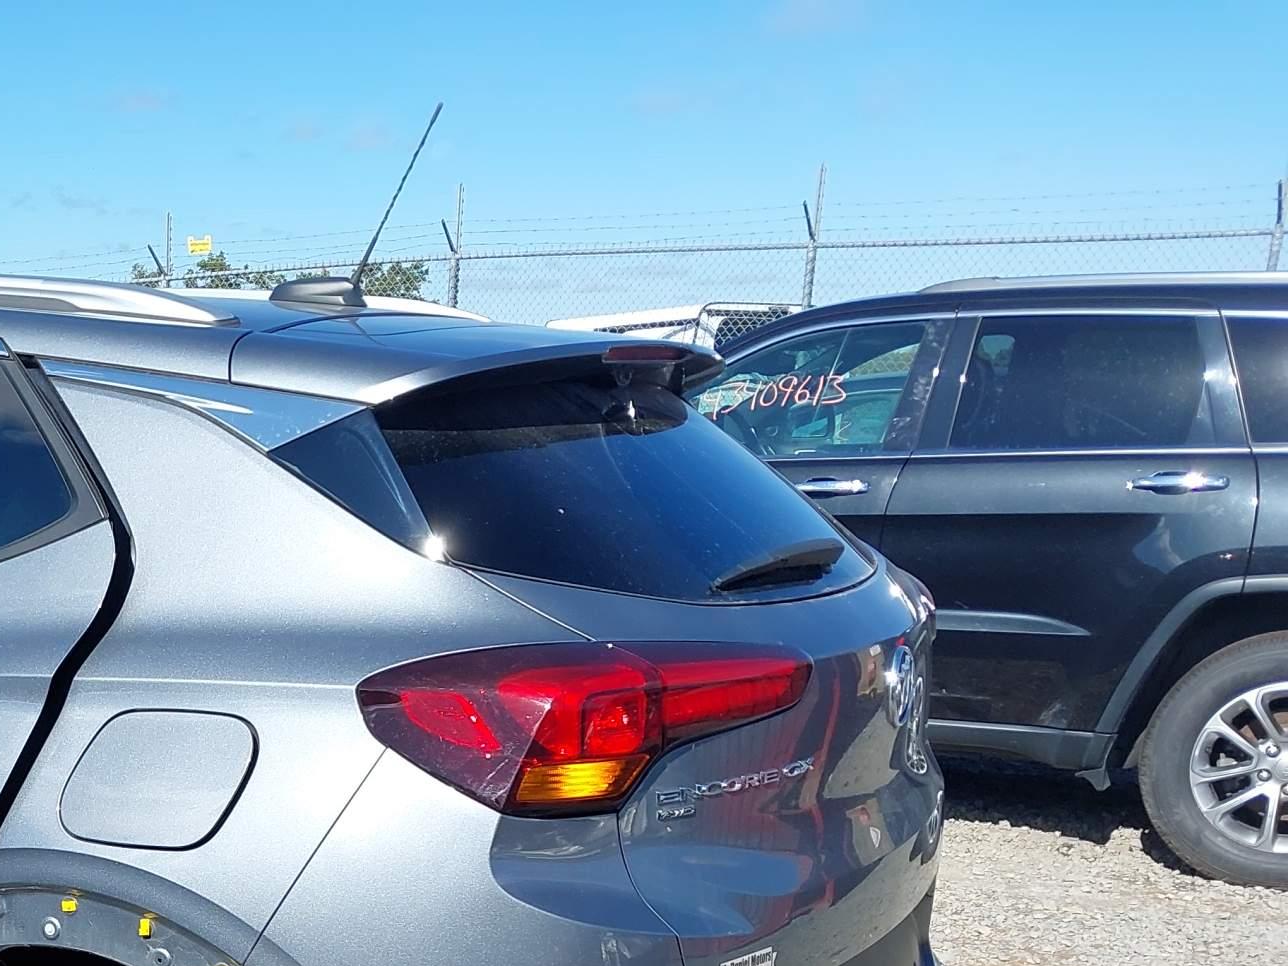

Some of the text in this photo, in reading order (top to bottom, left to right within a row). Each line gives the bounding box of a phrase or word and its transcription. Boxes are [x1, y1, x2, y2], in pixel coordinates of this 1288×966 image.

[703, 374, 847, 421] 43409613
[655, 756, 815, 806] ENCORE GX
